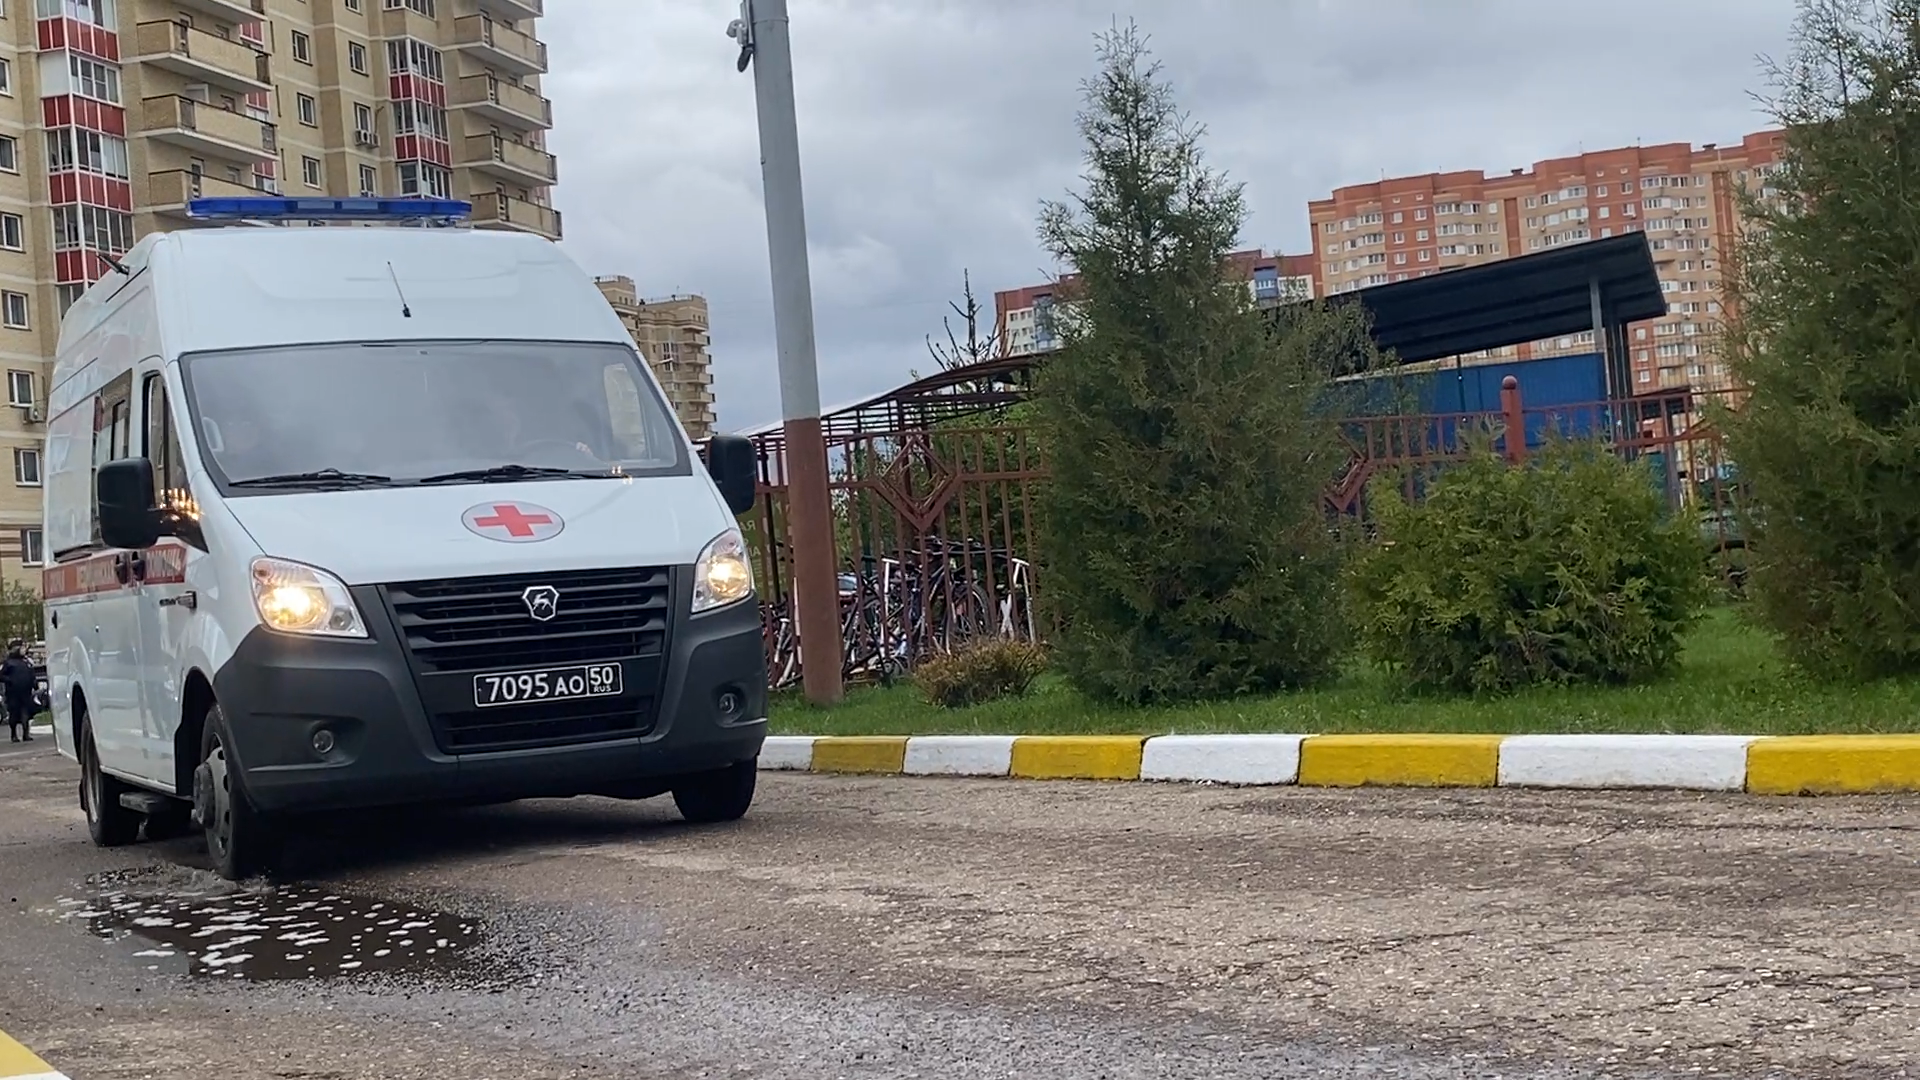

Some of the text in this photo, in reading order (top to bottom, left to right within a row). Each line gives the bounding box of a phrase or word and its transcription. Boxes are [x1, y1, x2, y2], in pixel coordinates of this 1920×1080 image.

[485, 666, 613, 702] 7095 AO 50
[593, 684, 612, 693] RUS
